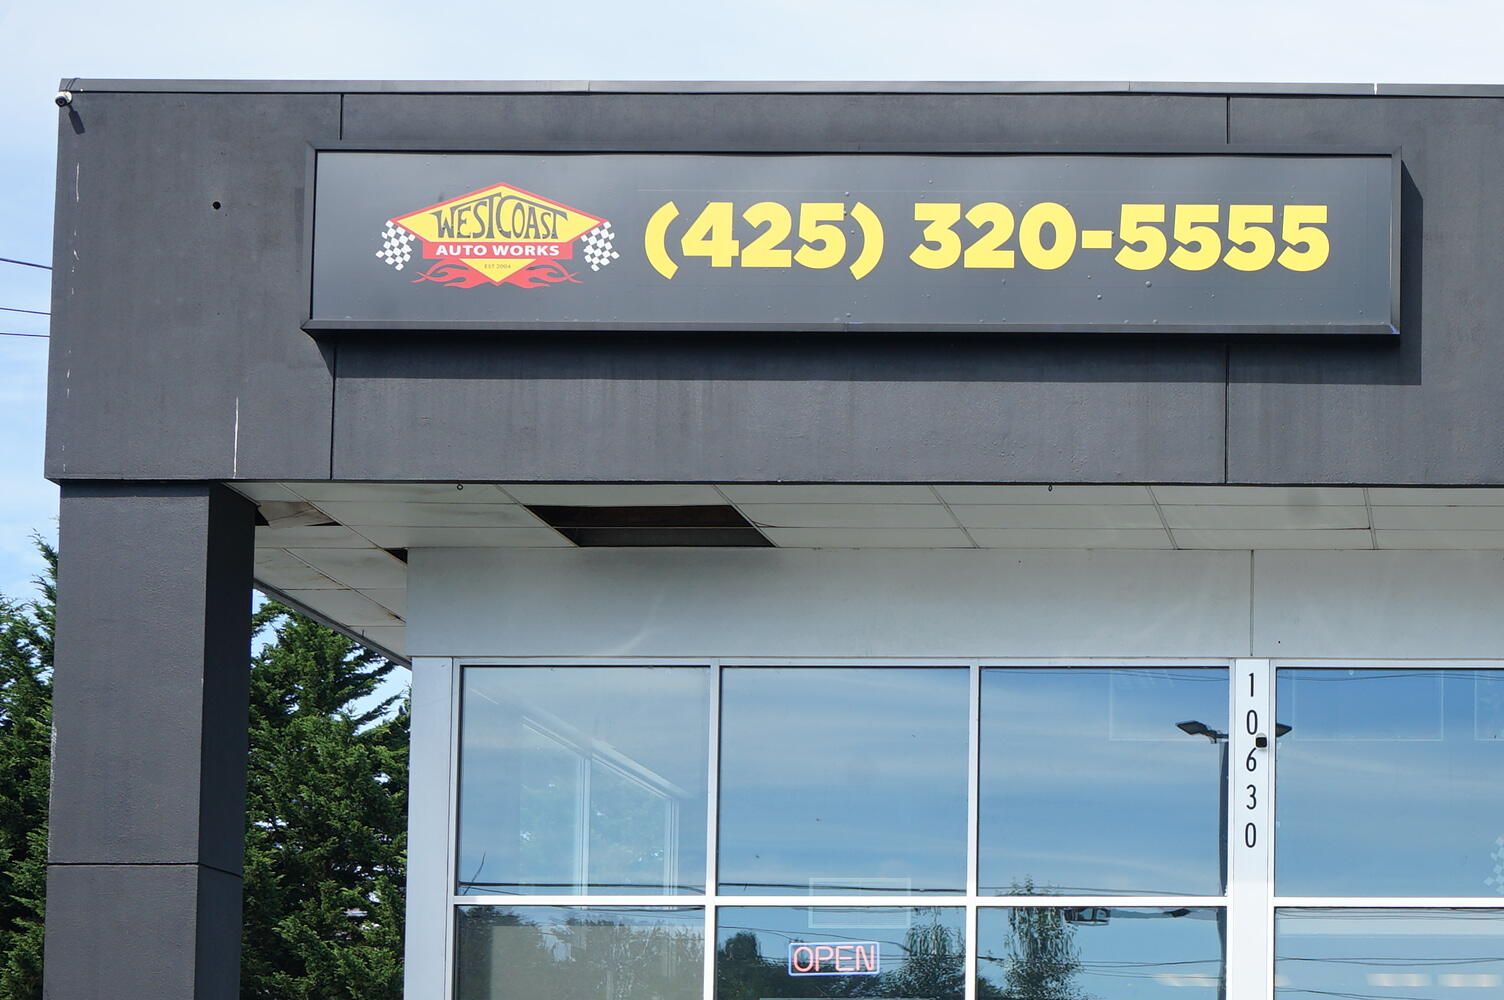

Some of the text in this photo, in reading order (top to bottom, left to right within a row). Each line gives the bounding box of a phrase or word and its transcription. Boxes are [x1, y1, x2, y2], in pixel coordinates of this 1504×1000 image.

[431, 192, 568, 239] WESTCOAST
[435, 245, 560, 256] AUTO WORKS
[644, 201, 1330, 280] (425) 320-5555
[1245, 672, 1258, 848] 10630
[792, 944, 876, 973] OPEN
